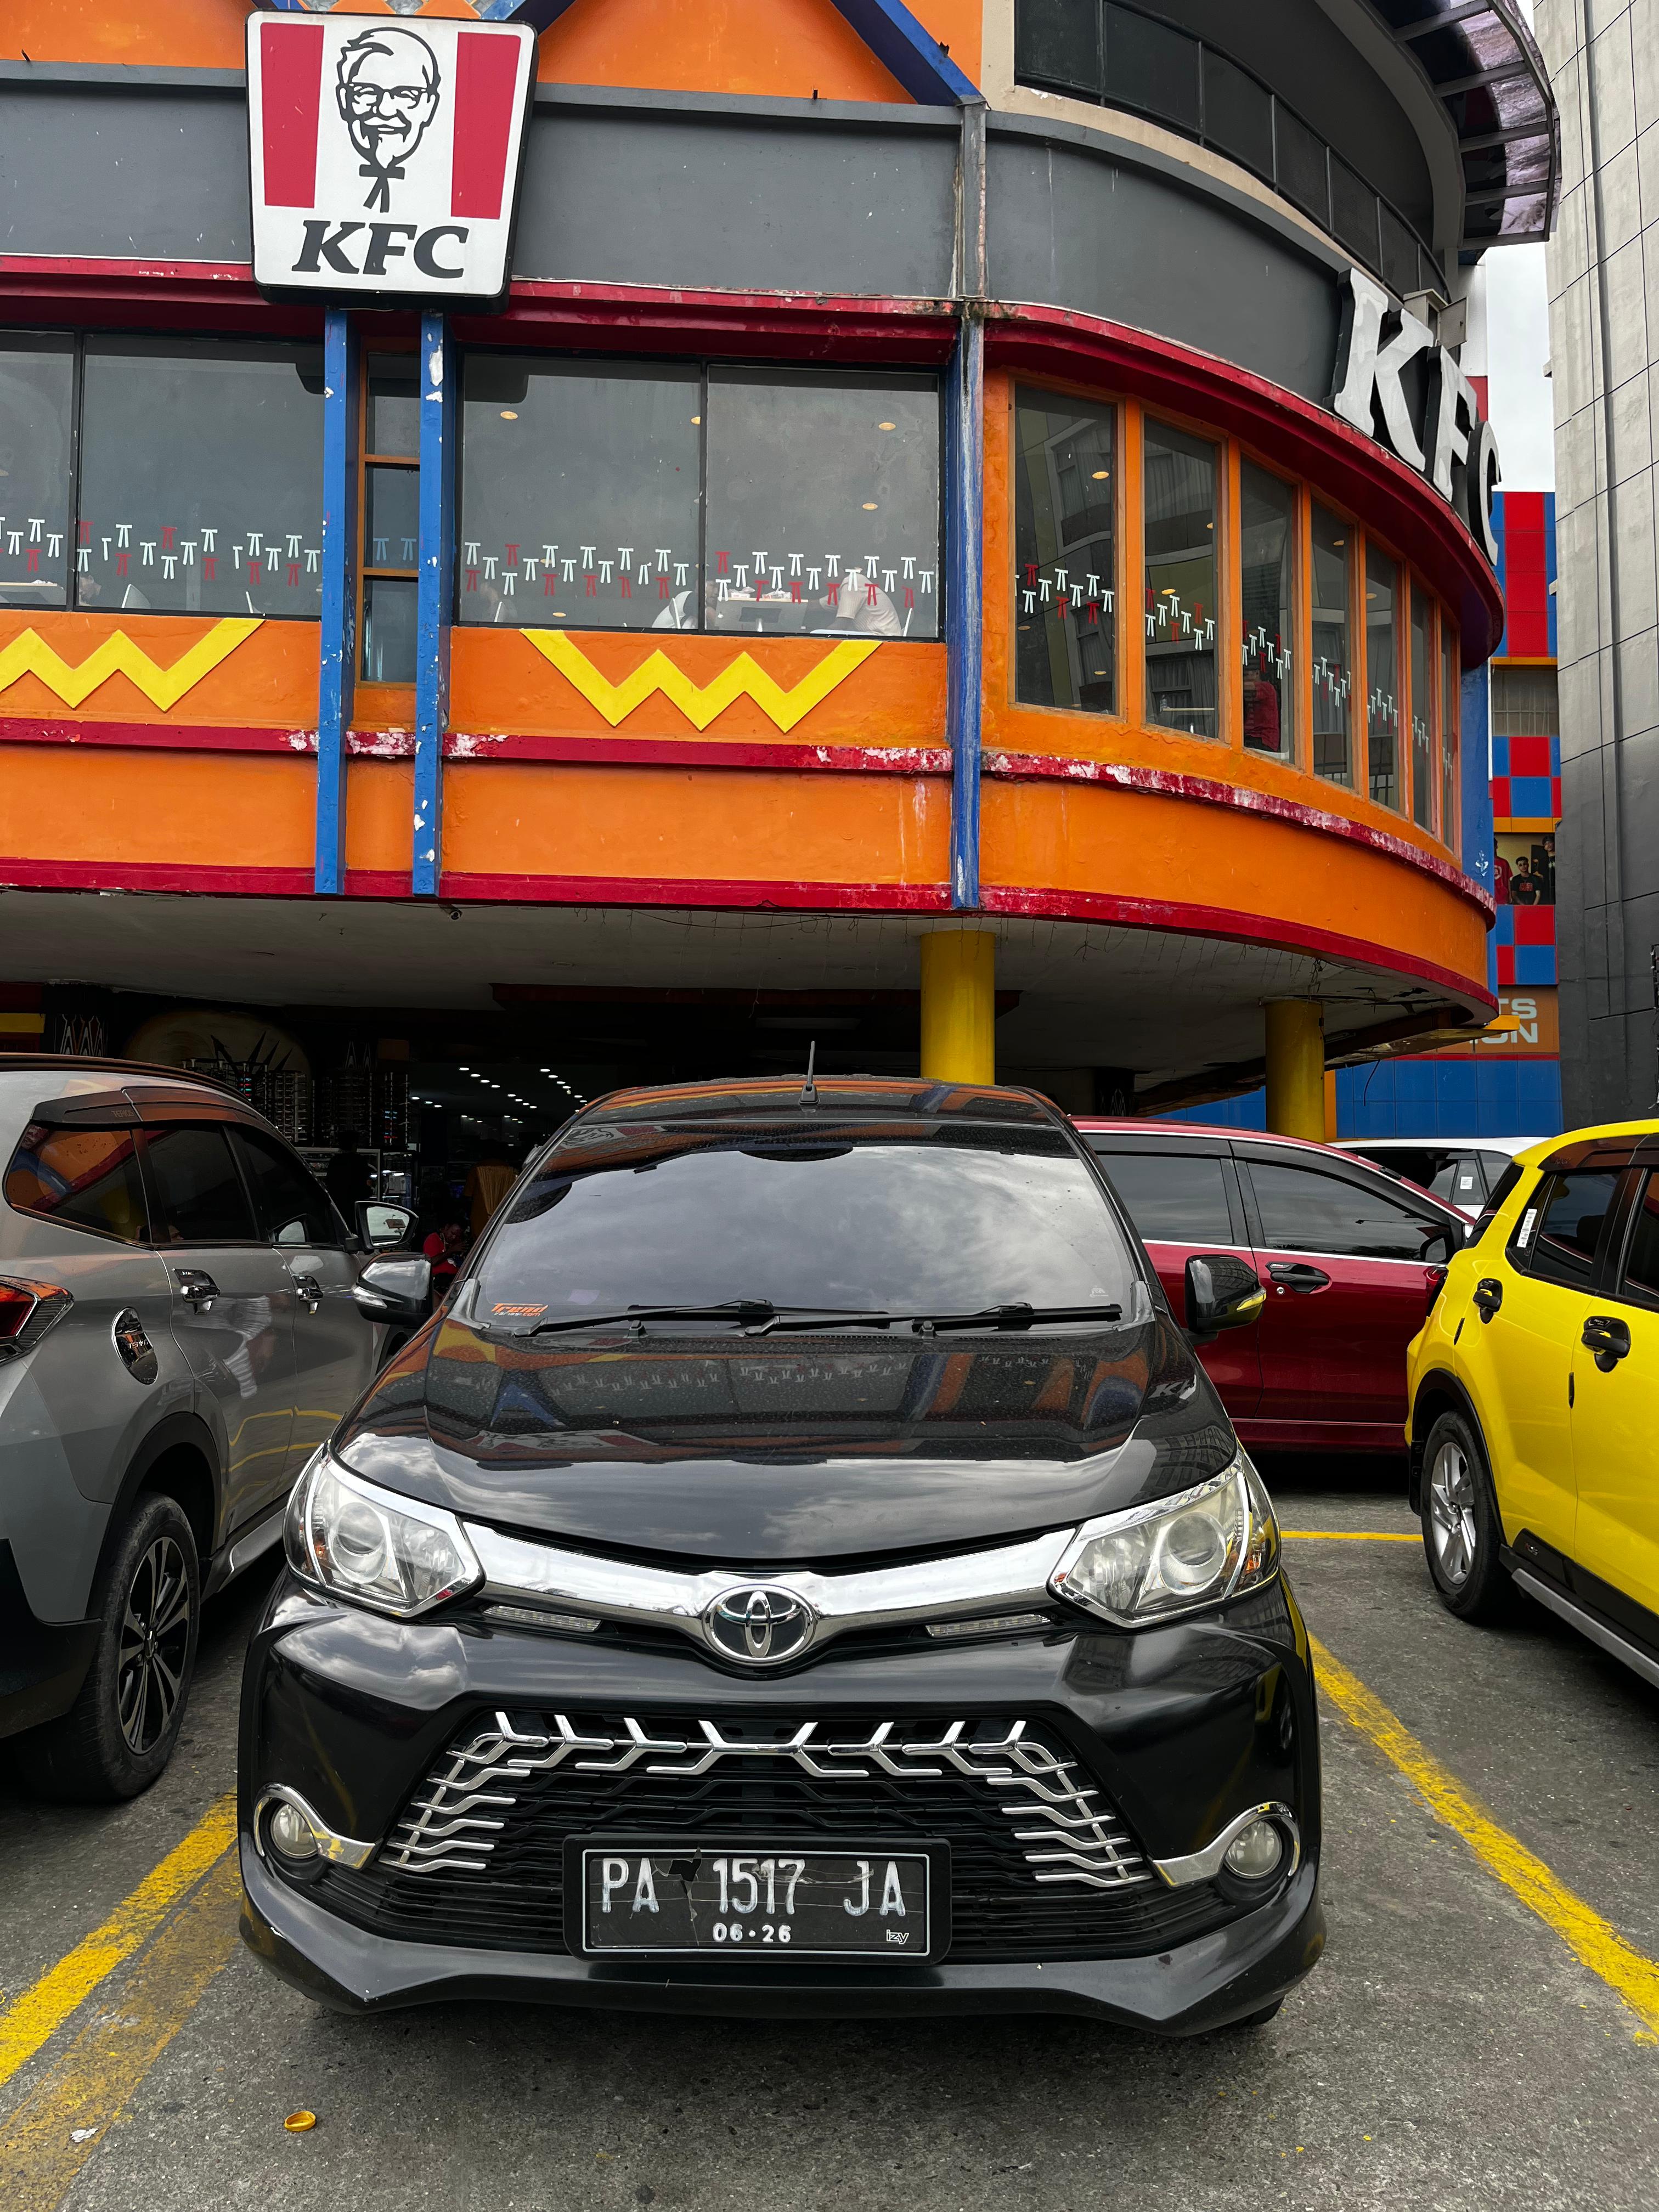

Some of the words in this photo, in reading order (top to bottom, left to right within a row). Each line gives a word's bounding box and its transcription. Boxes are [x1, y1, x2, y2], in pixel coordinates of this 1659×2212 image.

[291, 220, 469, 279] KFC
[1334, 267, 1502, 566] KFC
[491, 1303, 549, 1312] Trend
[602, 1858, 659, 1914] PA
[713, 1858, 806, 1915] 1517
[843, 1860, 907, 1917] JA
